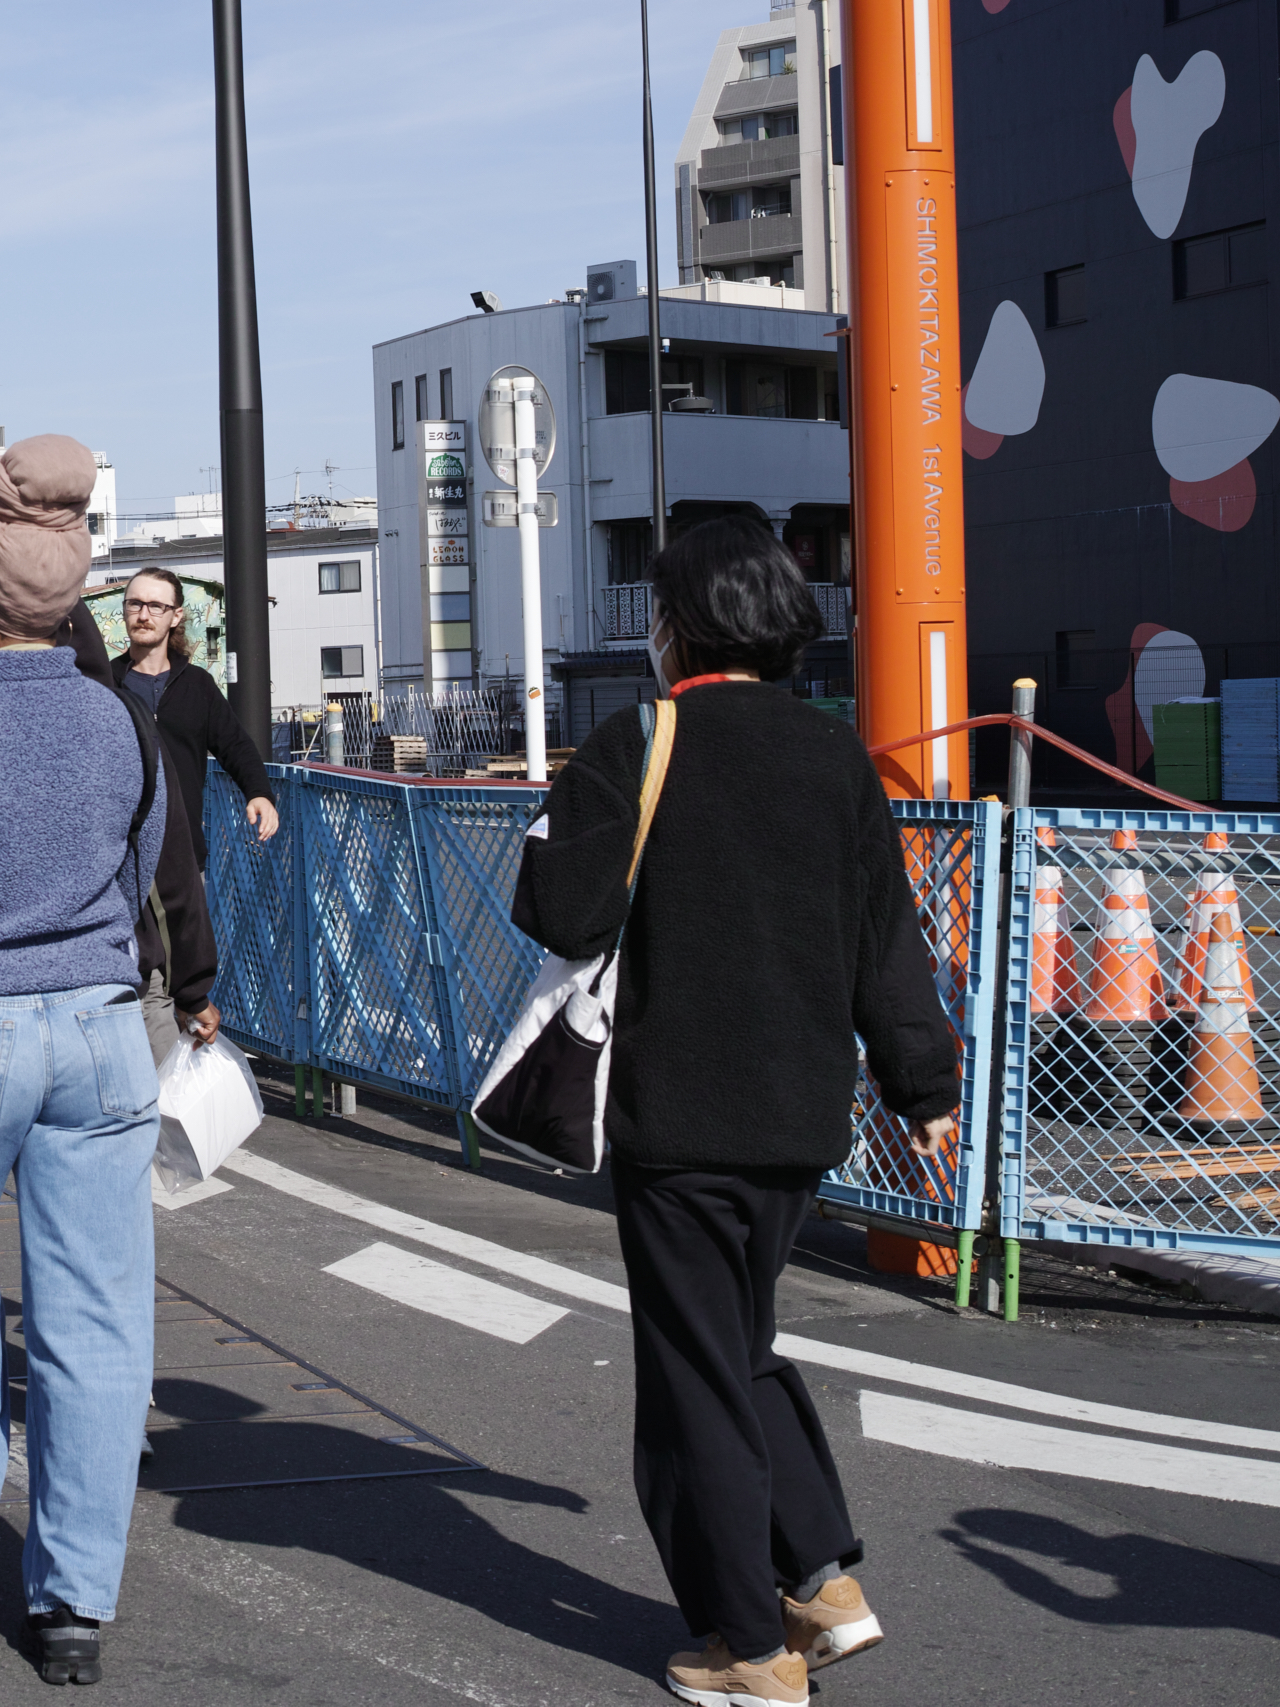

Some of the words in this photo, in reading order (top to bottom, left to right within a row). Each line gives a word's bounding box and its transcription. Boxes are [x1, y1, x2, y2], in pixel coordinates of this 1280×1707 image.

[916, 197, 942, 425] SHIMOKITAZAWA
[430, 466, 462, 476] RECORDS
[923, 443, 942, 478] 1st
[924, 481, 943, 576] Avenue
[432, 545, 464, 554] LEMON
[432, 554, 465, 563] GLASS
